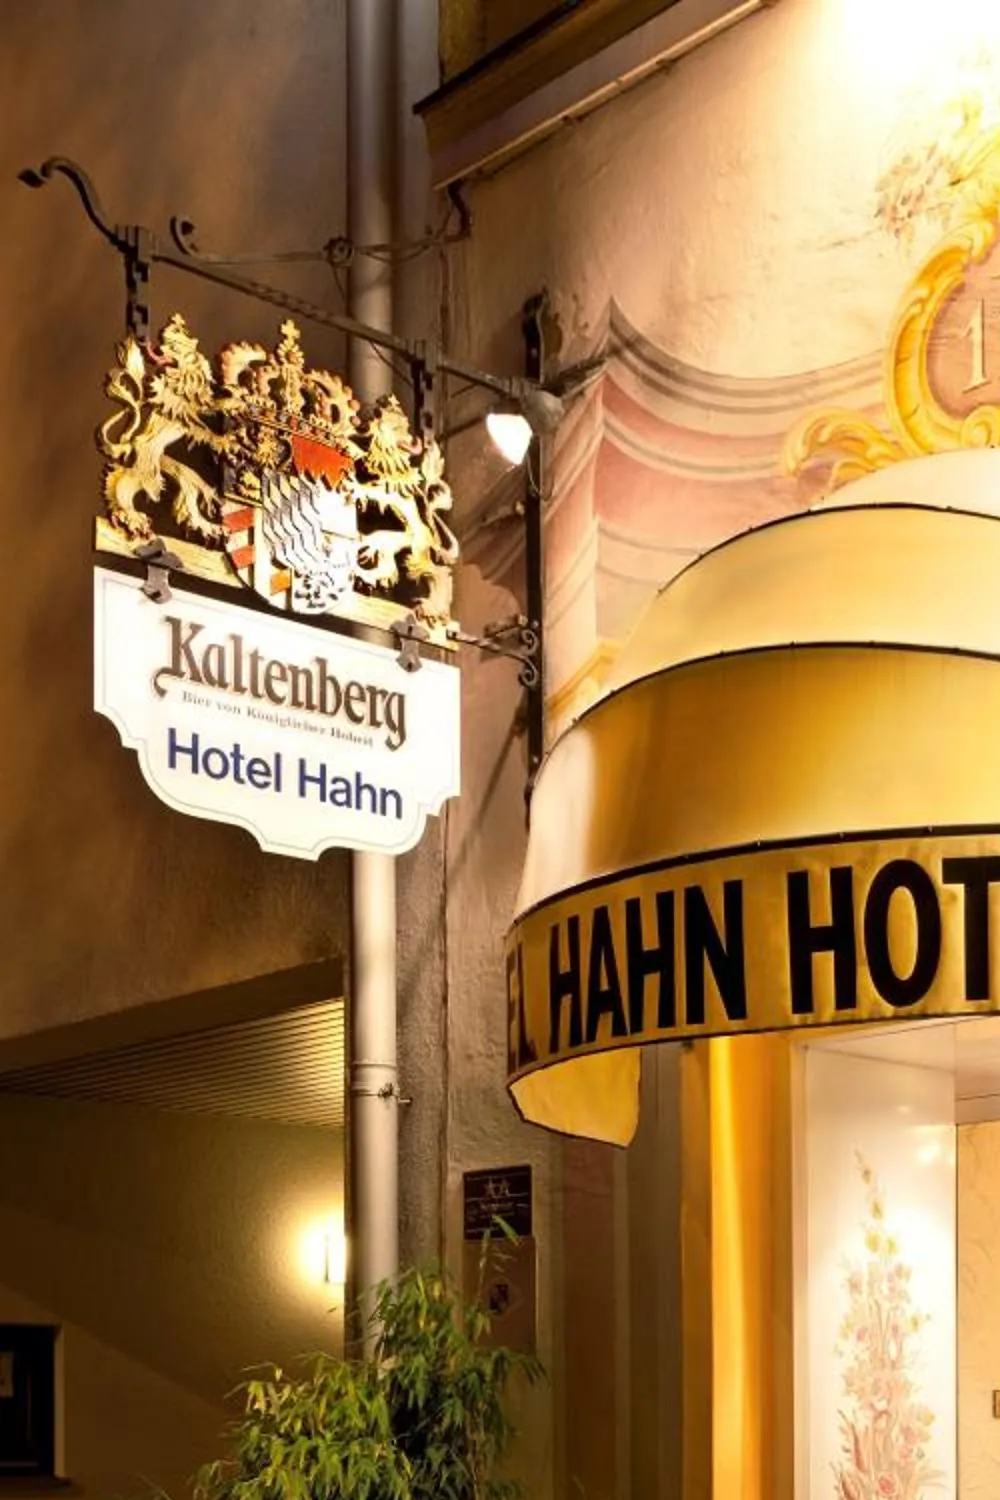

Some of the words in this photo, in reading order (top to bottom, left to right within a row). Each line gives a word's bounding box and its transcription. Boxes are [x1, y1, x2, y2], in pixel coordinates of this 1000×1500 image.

[153, 616, 407, 751] Kaltenberg
[168, 727, 282, 792] Hotel
[299, 757, 403, 820] Hahn
[549, 880, 748, 1054] HAHN
